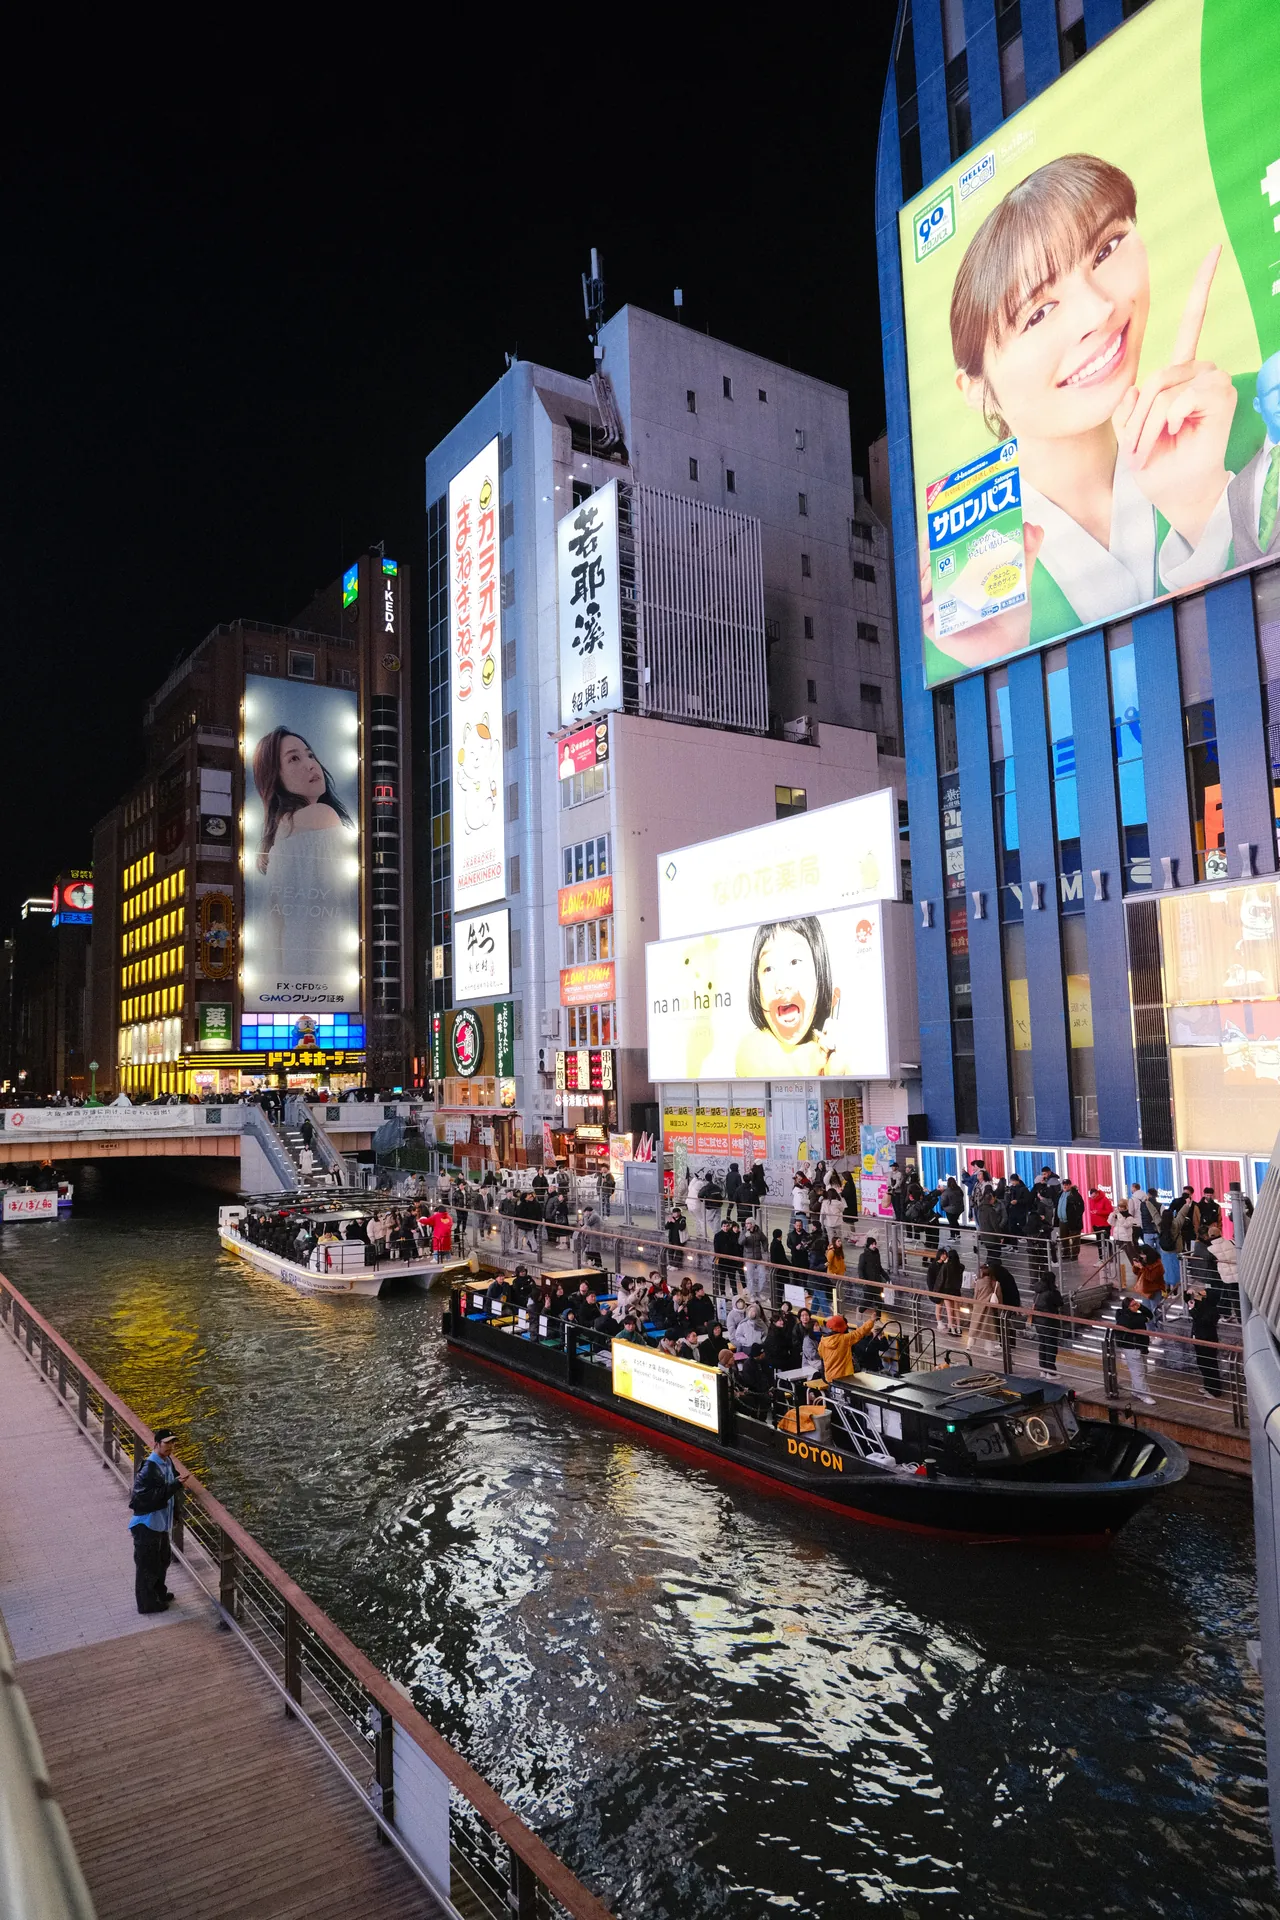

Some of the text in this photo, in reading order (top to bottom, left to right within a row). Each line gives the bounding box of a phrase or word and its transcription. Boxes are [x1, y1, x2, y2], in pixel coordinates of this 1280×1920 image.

[961, 156, 992, 185] HELLO!
[919, 206, 944, 244] 90
[921, 228, 948, 254] サロンパス
[1002, 445, 1015, 459] 40
[932, 478, 1016, 542] サロンパス
[477, 508, 496, 657] カラオケ
[384, 579, 395, 634] IKEDA
[455, 499, 474, 698] まねきねこ
[465, 851, 493, 868] KARAOKE
[457, 863, 502, 888] MANEKINEKO
[562, 885, 610, 917] LONG DINH
[564, 967, 610, 987] LONG DINH
[259, 994, 344, 1003] GMOクリック証券
[206, 1007, 226, 1027] 薬
[463, 1010, 476, 1023] Pork
[556, 1053, 564, 1089] たこ焼き
[602, 1050, 612, 1090] 串かつ
[828, 1101, 841, 1158] 欢迎光临
[1157, 1188, 1173, 1197] Street
[787, 1438, 844, 1473] DOTON
